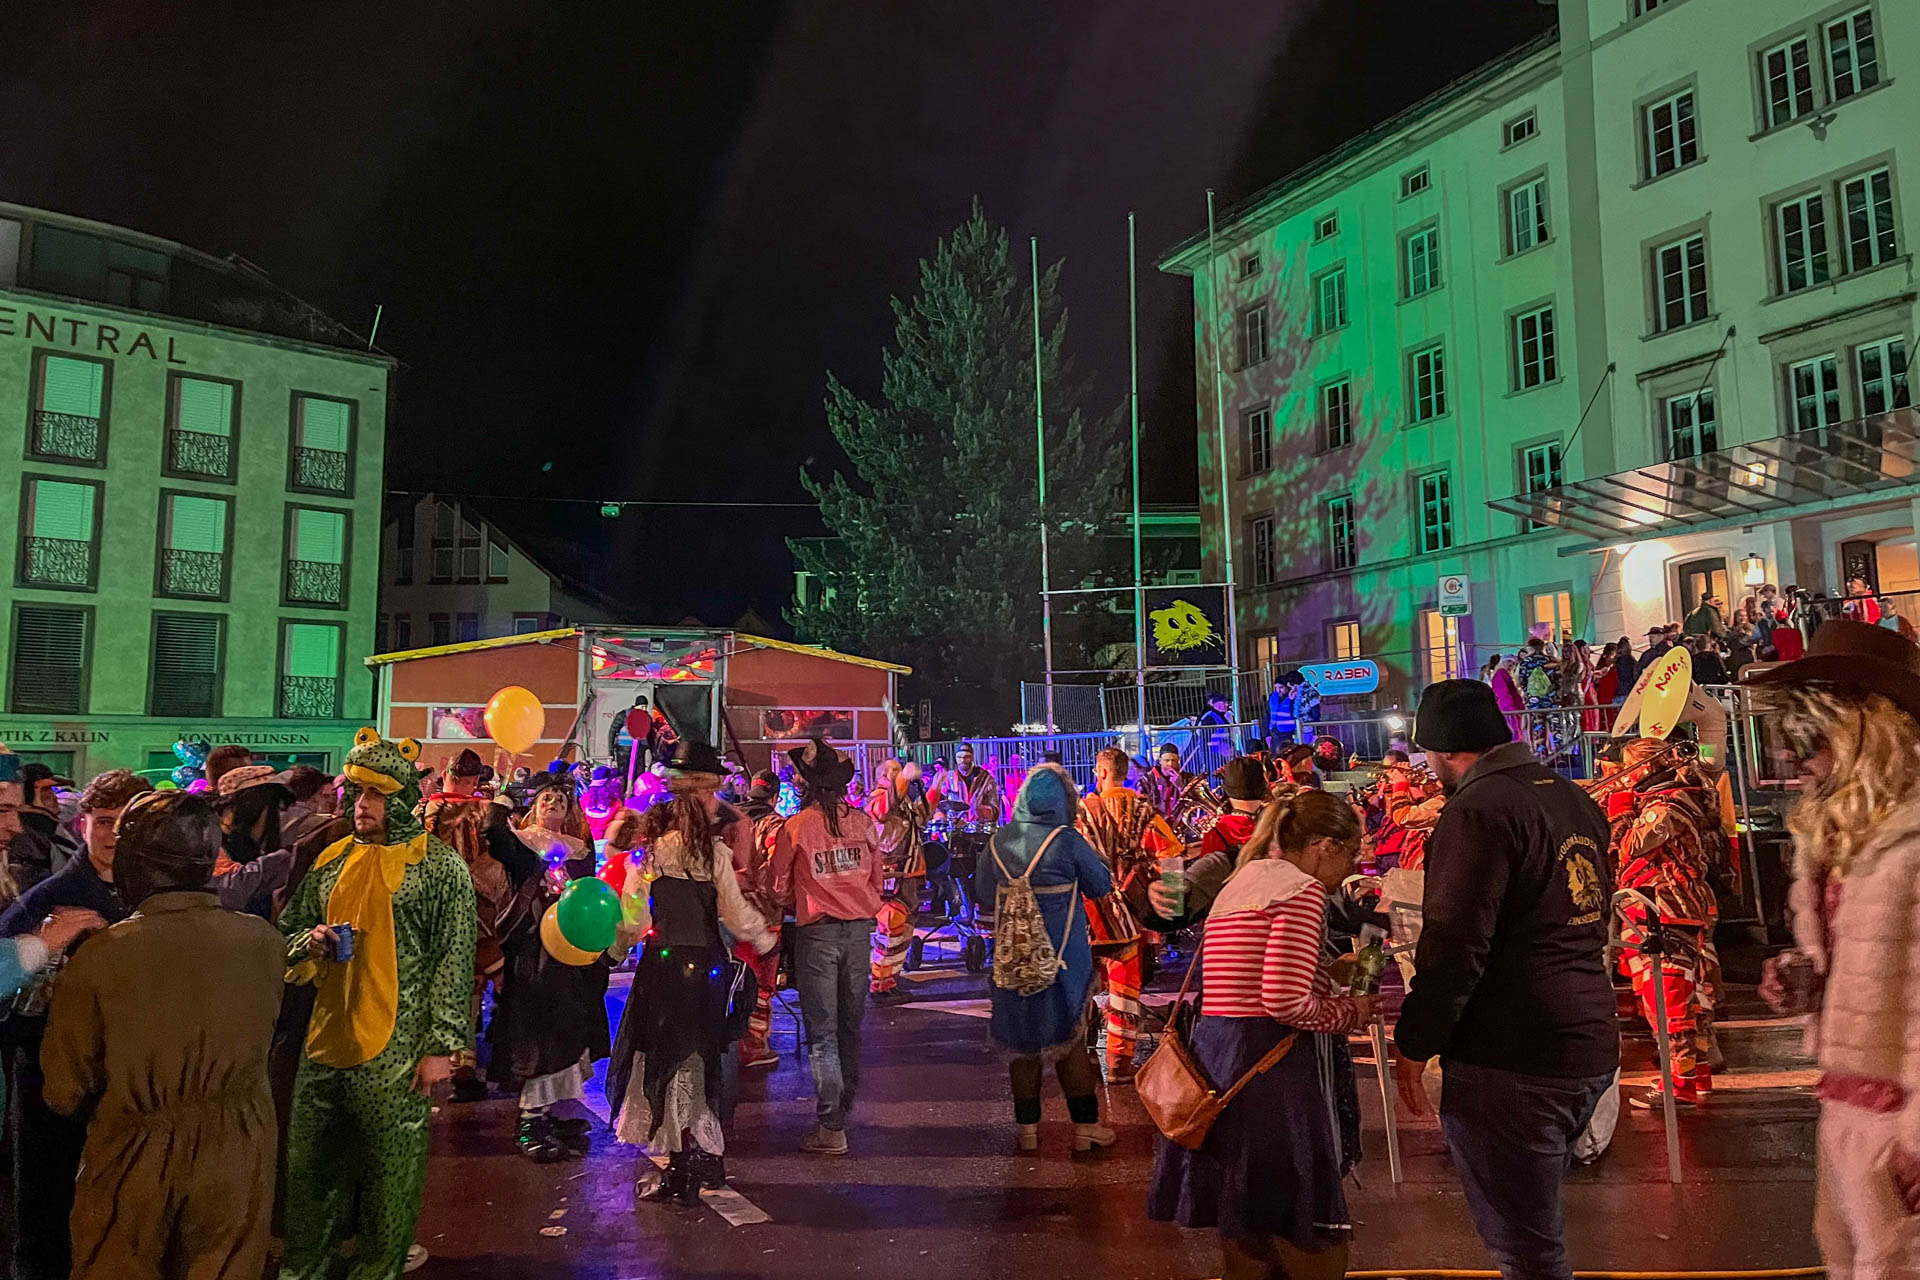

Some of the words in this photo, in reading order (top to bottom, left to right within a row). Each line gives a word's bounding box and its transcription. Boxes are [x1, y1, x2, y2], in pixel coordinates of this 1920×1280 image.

[1324, 666, 1371, 681] RABEN
[0, 730, 34, 742] TIK
[178, 733, 311, 745] KONTAKTLINSEN
